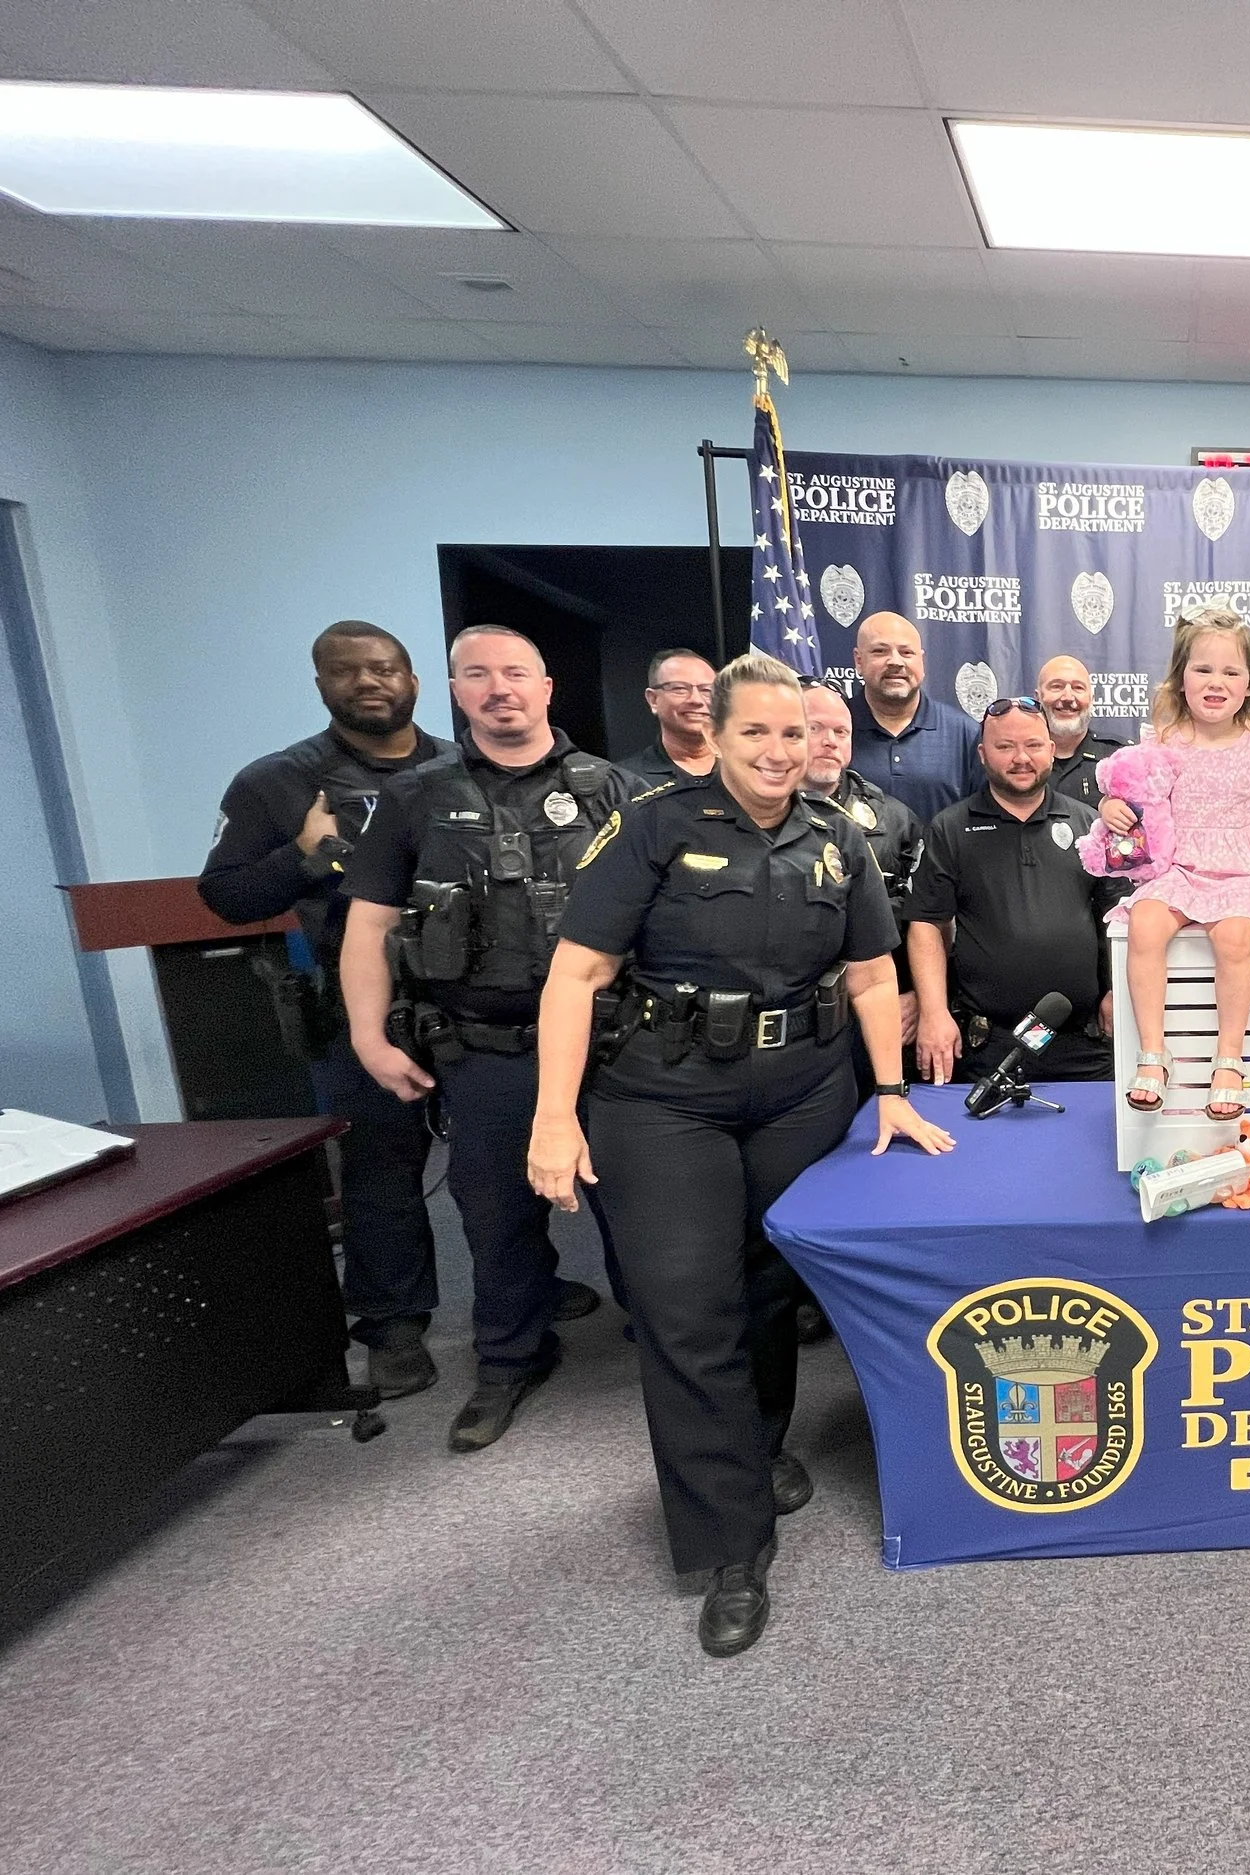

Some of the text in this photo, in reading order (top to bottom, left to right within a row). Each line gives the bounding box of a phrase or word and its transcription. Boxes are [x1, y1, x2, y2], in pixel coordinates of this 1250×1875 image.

[787, 473, 896, 490] ST. AUGUSTINE
[1038, 482, 1144, 497] ST. AUGUSTINE
[790, 485, 896, 513] POLICE
[1038, 494, 1144, 519] POLICE
[1039, 517, 1145, 532] DEPARTMENT
[914, 573, 1021, 589] ST. AUGUSTINE
[1163, 581, 1183, 593] ST.
[914, 585, 1022, 611] POLICE
[916, 607, 1022, 623] DEPARTMENT
[1088, 673, 1149, 685] GUSTINE
[1091, 684, 1149, 706] LICE
[964, 1295, 1120, 1337] POLICE
[1057, 1381, 1126, 1498] FOUNDED 1565
